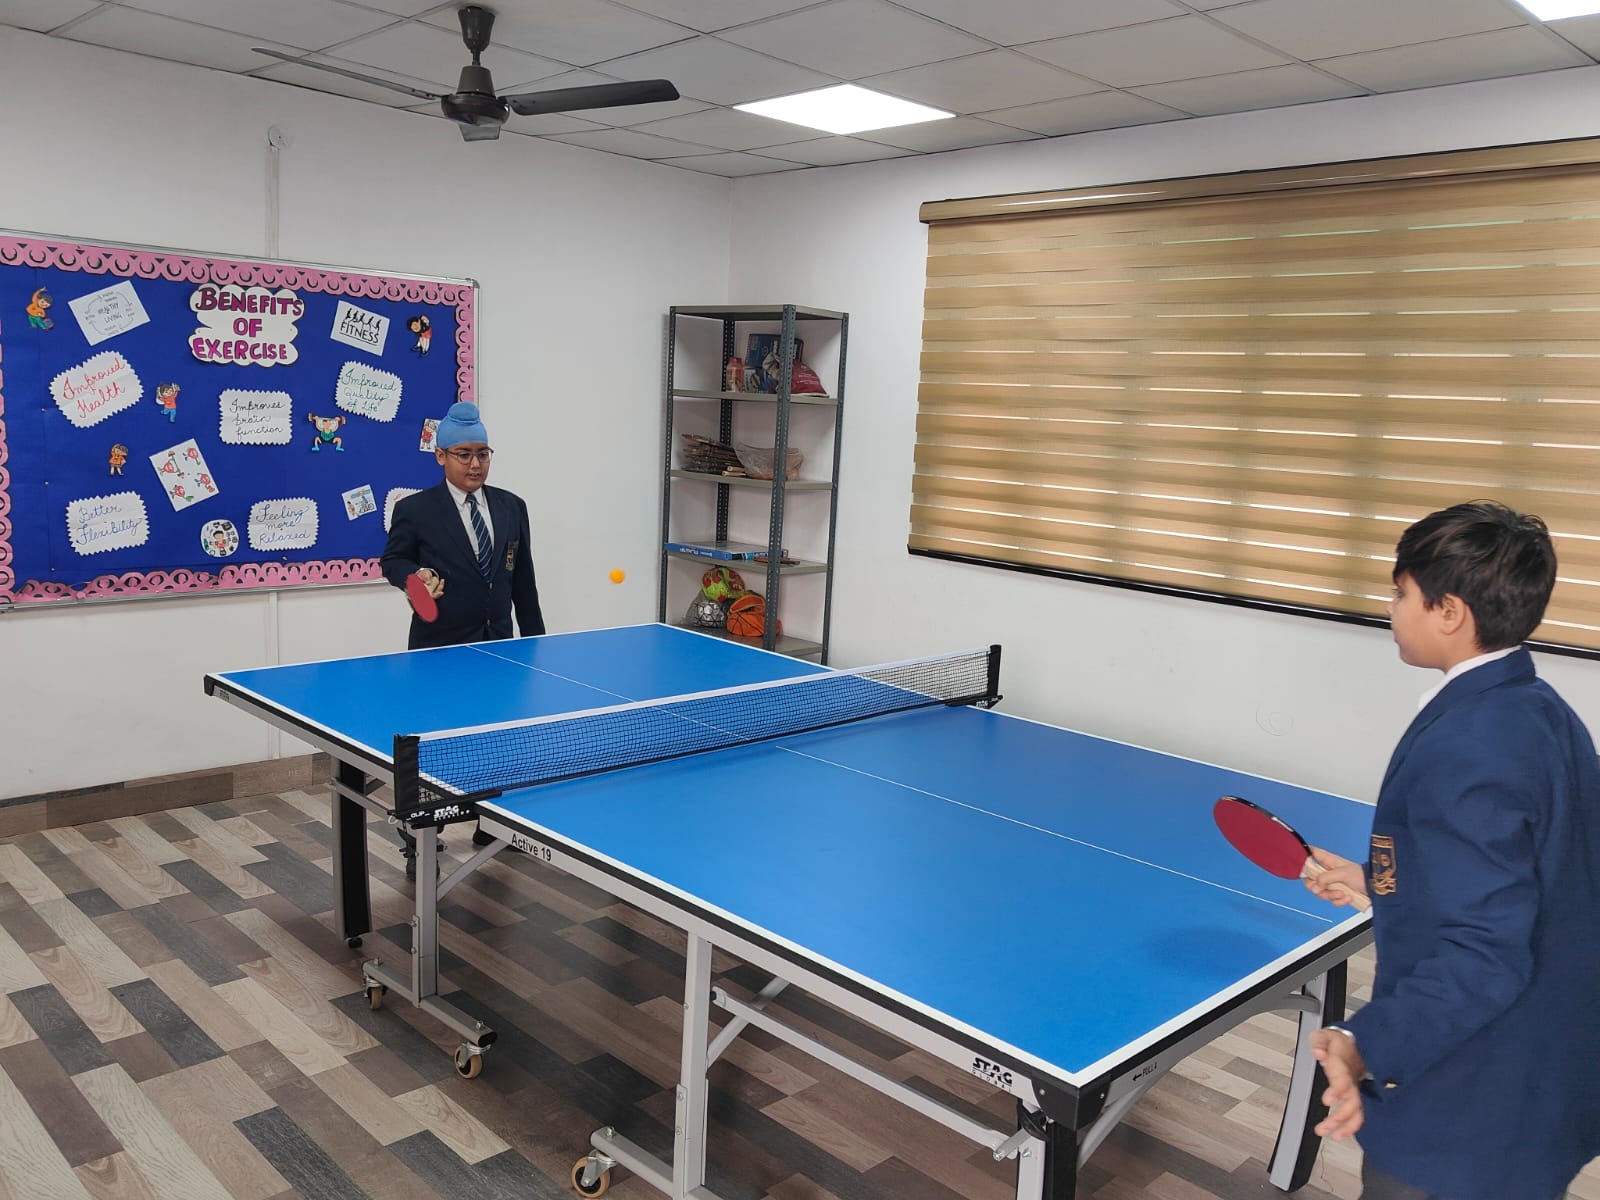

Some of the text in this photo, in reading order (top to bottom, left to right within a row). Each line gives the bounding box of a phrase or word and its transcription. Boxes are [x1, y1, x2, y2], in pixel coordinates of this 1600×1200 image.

[195, 287, 303, 316] BENEFITS
[233, 317, 263, 338] OF
[340, 321, 380, 344] FITNESS
[192, 337, 288, 360] EXERCISE
[62, 357, 126, 401] Improved
[77, 381, 126, 419] Health
[235, 426, 284, 441] function
[79, 504, 122, 524] Better
[255, 503, 310, 523] Feeling
[75, 518, 143, 545] Flexibility
[265, 520, 296, 531] more
[255, 530, 311, 547] Relaxed
[511, 833, 552, 862] Active 19
[972, 1057, 1013, 1085] STAG
